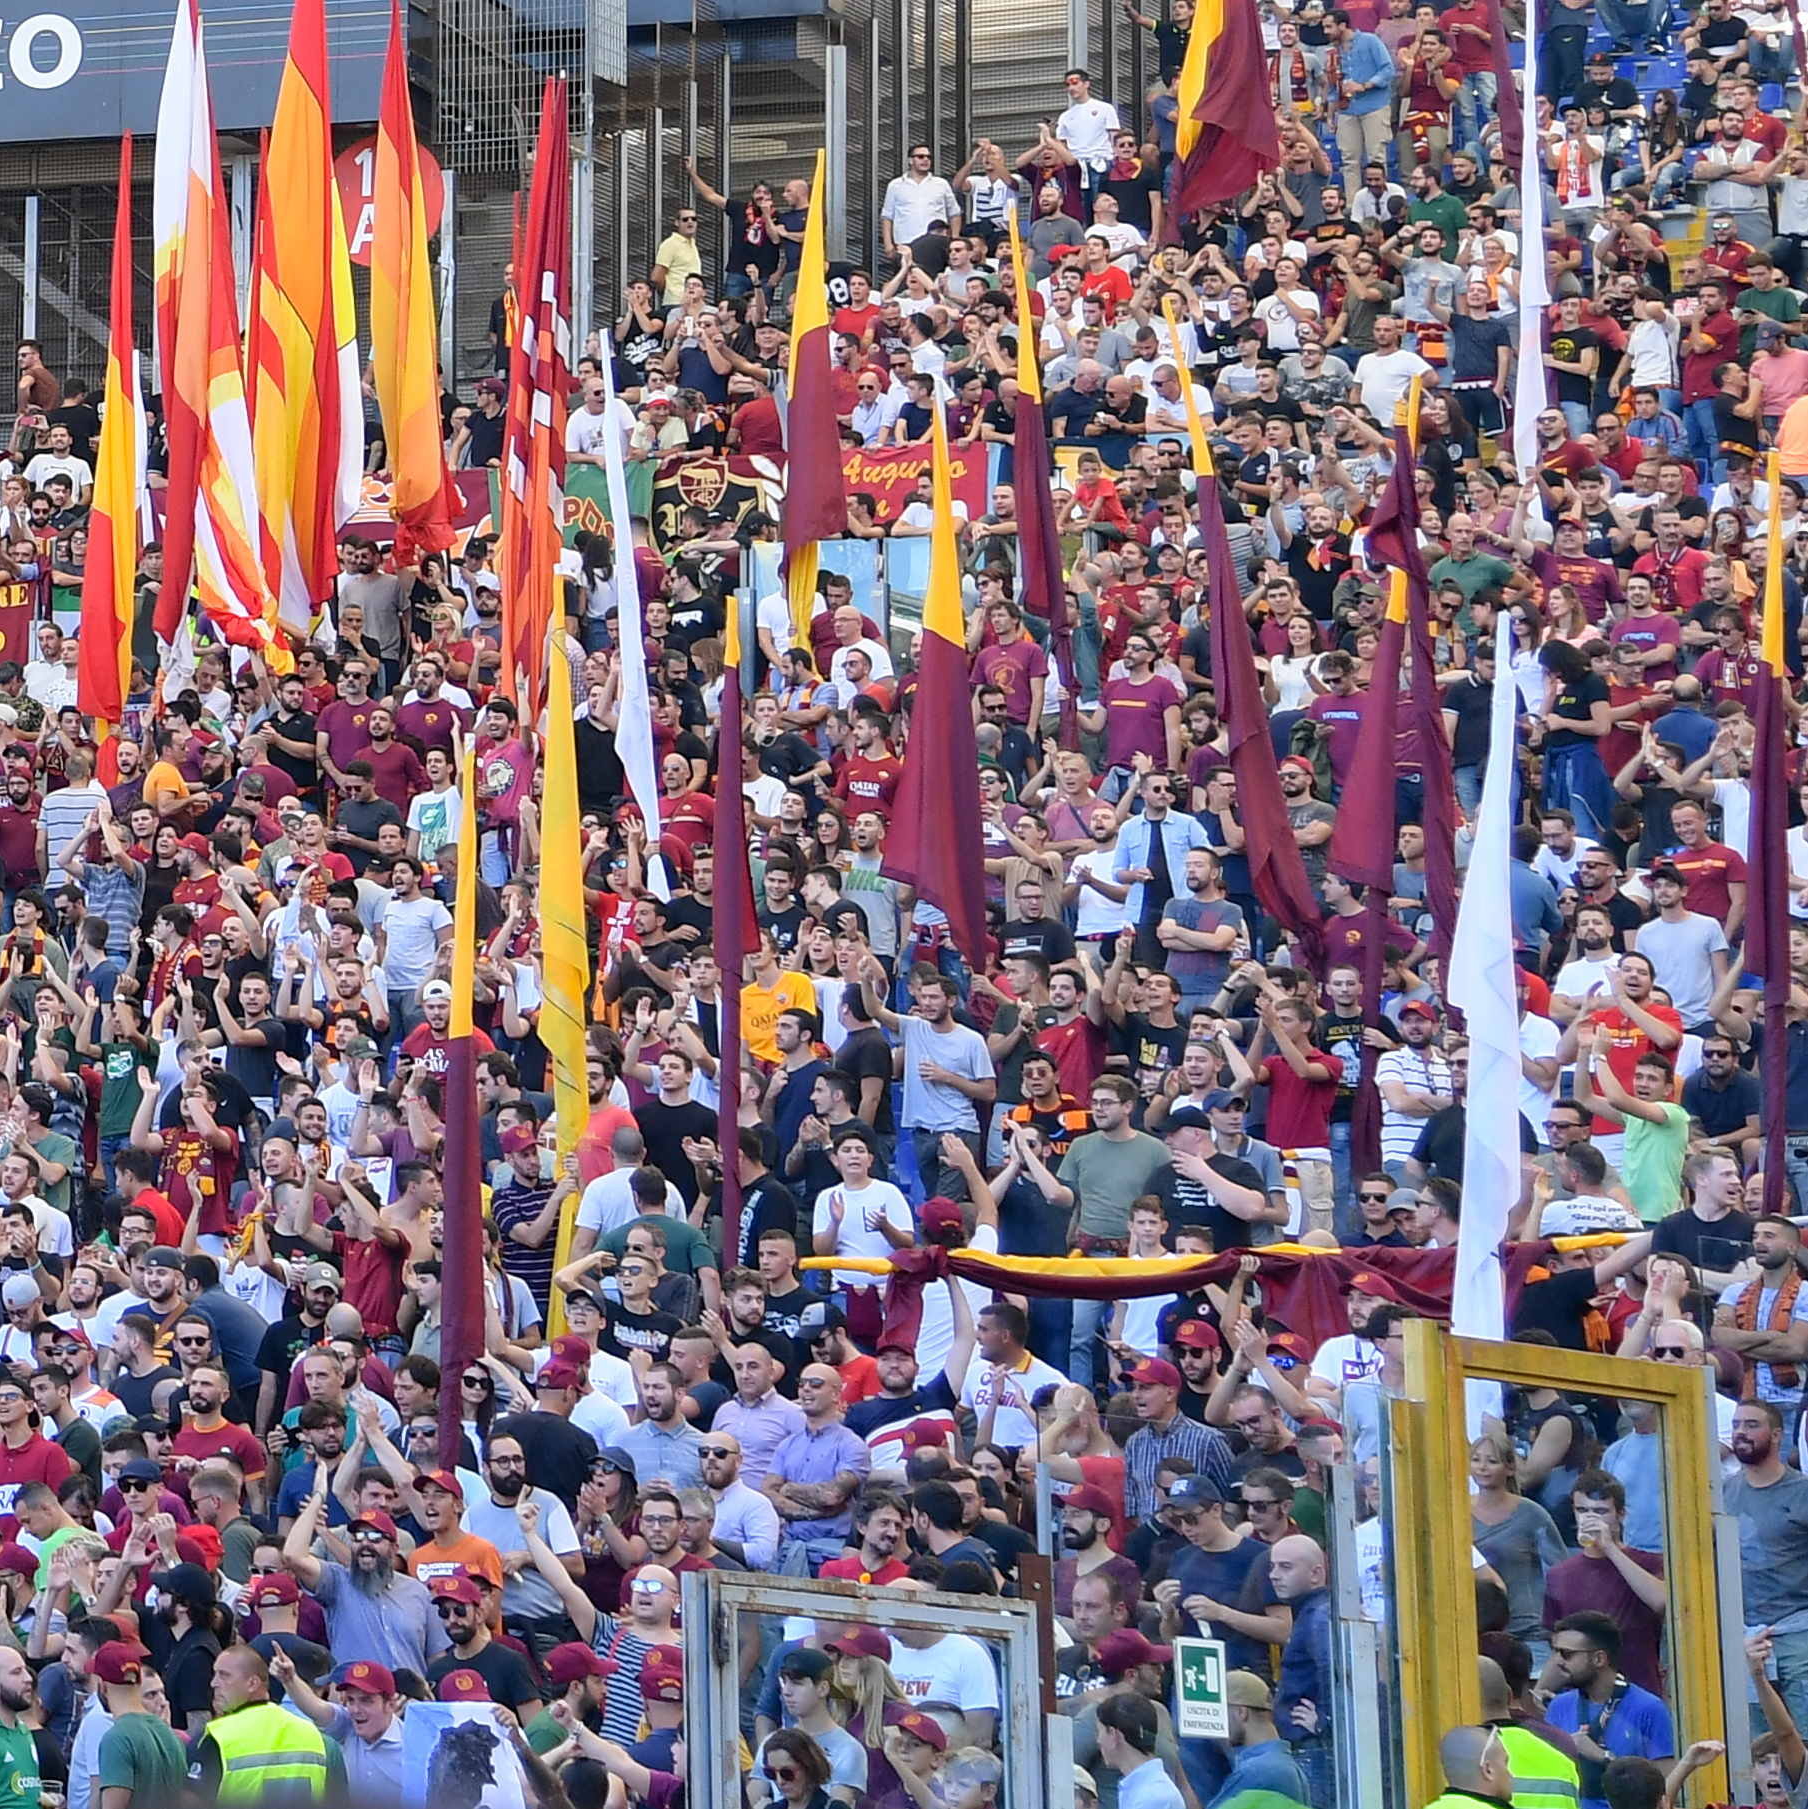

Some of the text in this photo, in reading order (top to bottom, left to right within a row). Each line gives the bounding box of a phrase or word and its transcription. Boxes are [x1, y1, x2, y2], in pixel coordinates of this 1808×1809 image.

[849, 781, 880, 792] QATAR
[1187, 1707, 1220, 1717] USCITA DI
[1184, 1720, 1225, 1731] EMERGENZA
